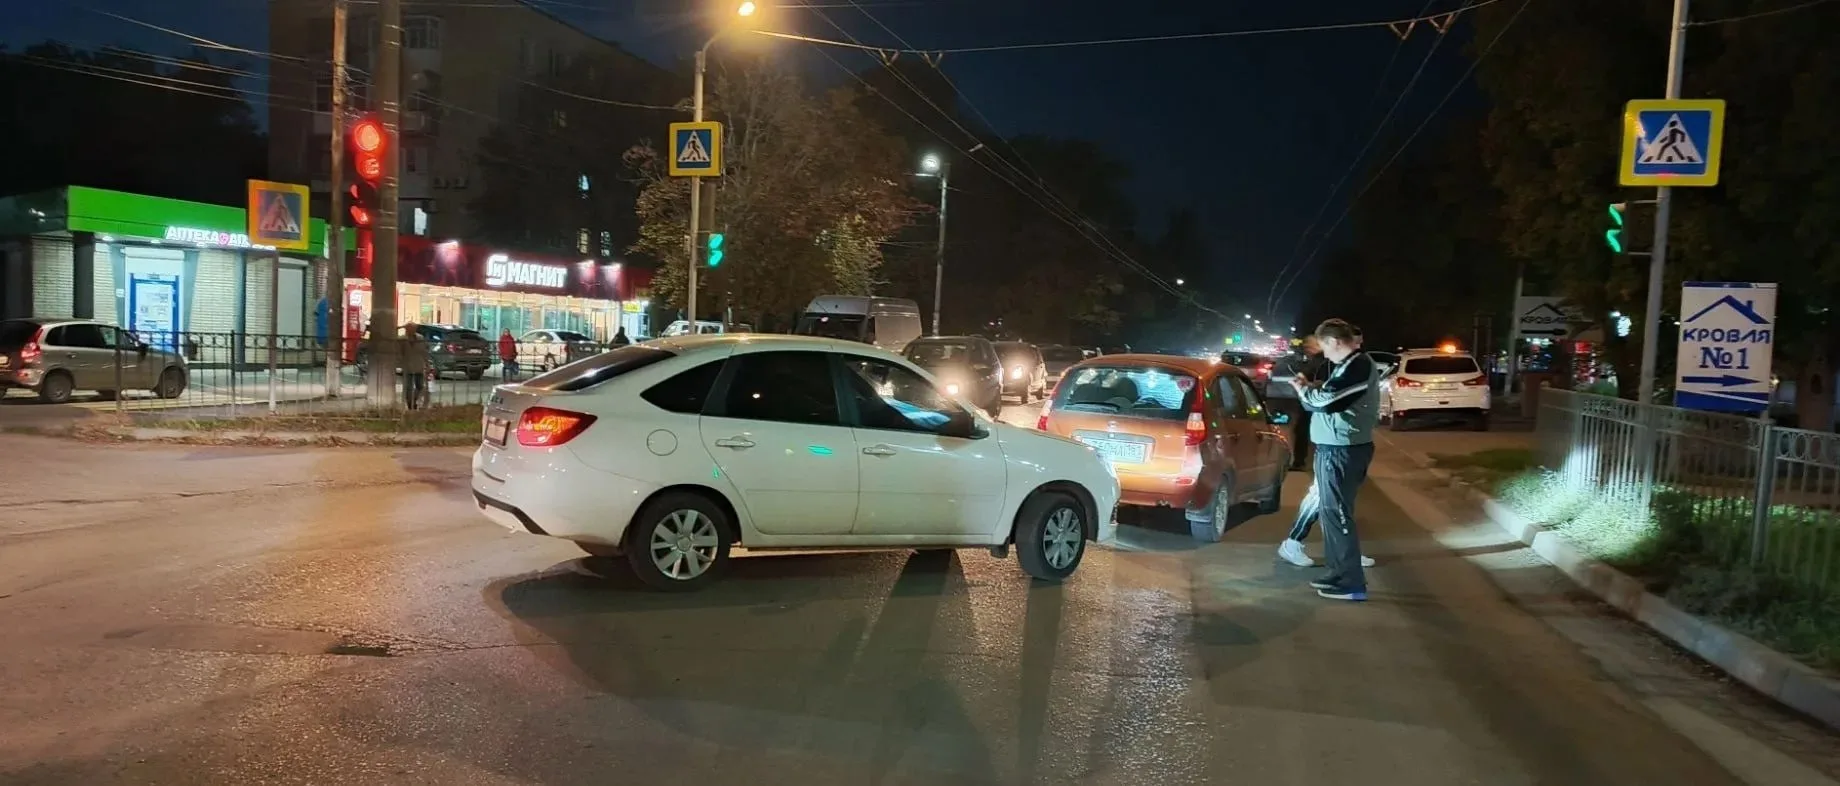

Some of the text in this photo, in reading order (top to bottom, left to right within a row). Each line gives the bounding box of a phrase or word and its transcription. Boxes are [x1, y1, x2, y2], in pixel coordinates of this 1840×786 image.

[165, 226, 219, 244] АПТЕКА
[507, 261, 567, 288] МАГНИТ
[1683, 328, 1771, 344] КРОВЛЯ
